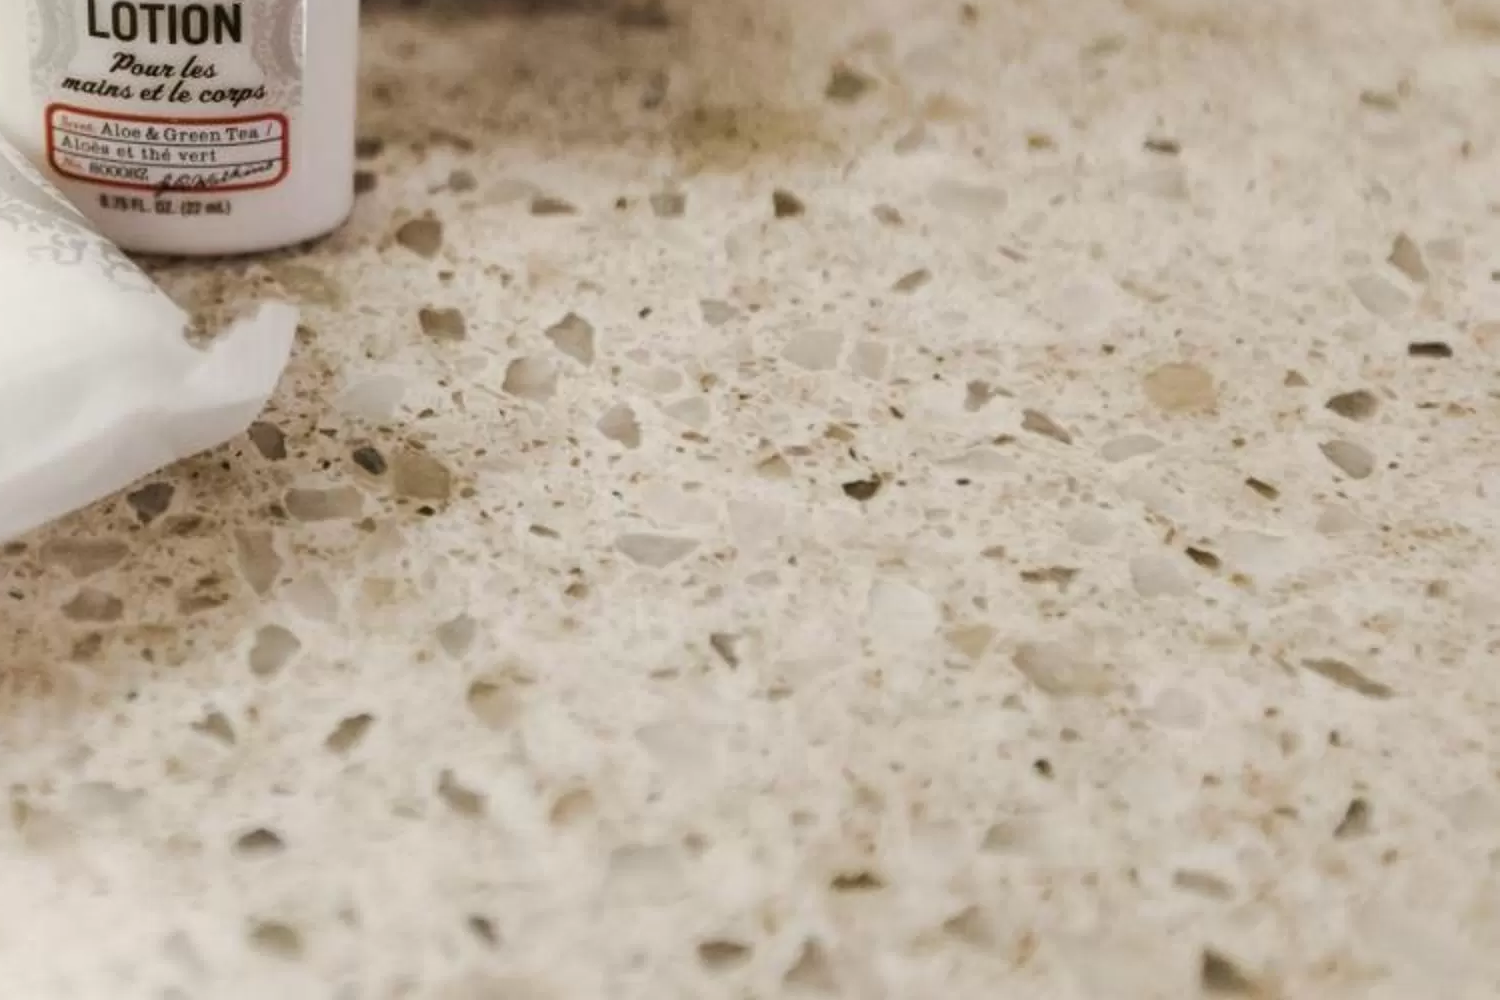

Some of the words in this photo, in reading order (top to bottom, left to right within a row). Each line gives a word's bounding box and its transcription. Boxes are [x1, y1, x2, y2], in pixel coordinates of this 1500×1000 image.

[109, 51, 175, 79] Pour
[180, 55, 218, 79] les
[62, 76, 133, 100] mains
[139, 82, 165, 102] et
[168, 79, 193, 103] le
[198, 85, 267, 108] corps
[101, 122, 141, 138] Aloe
[145, 126, 159, 140] &
[163, 128, 220, 142] Green
[225, 127, 259, 139] Tea
[116, 146, 134, 159] et
[178, 148, 216, 161] vert
